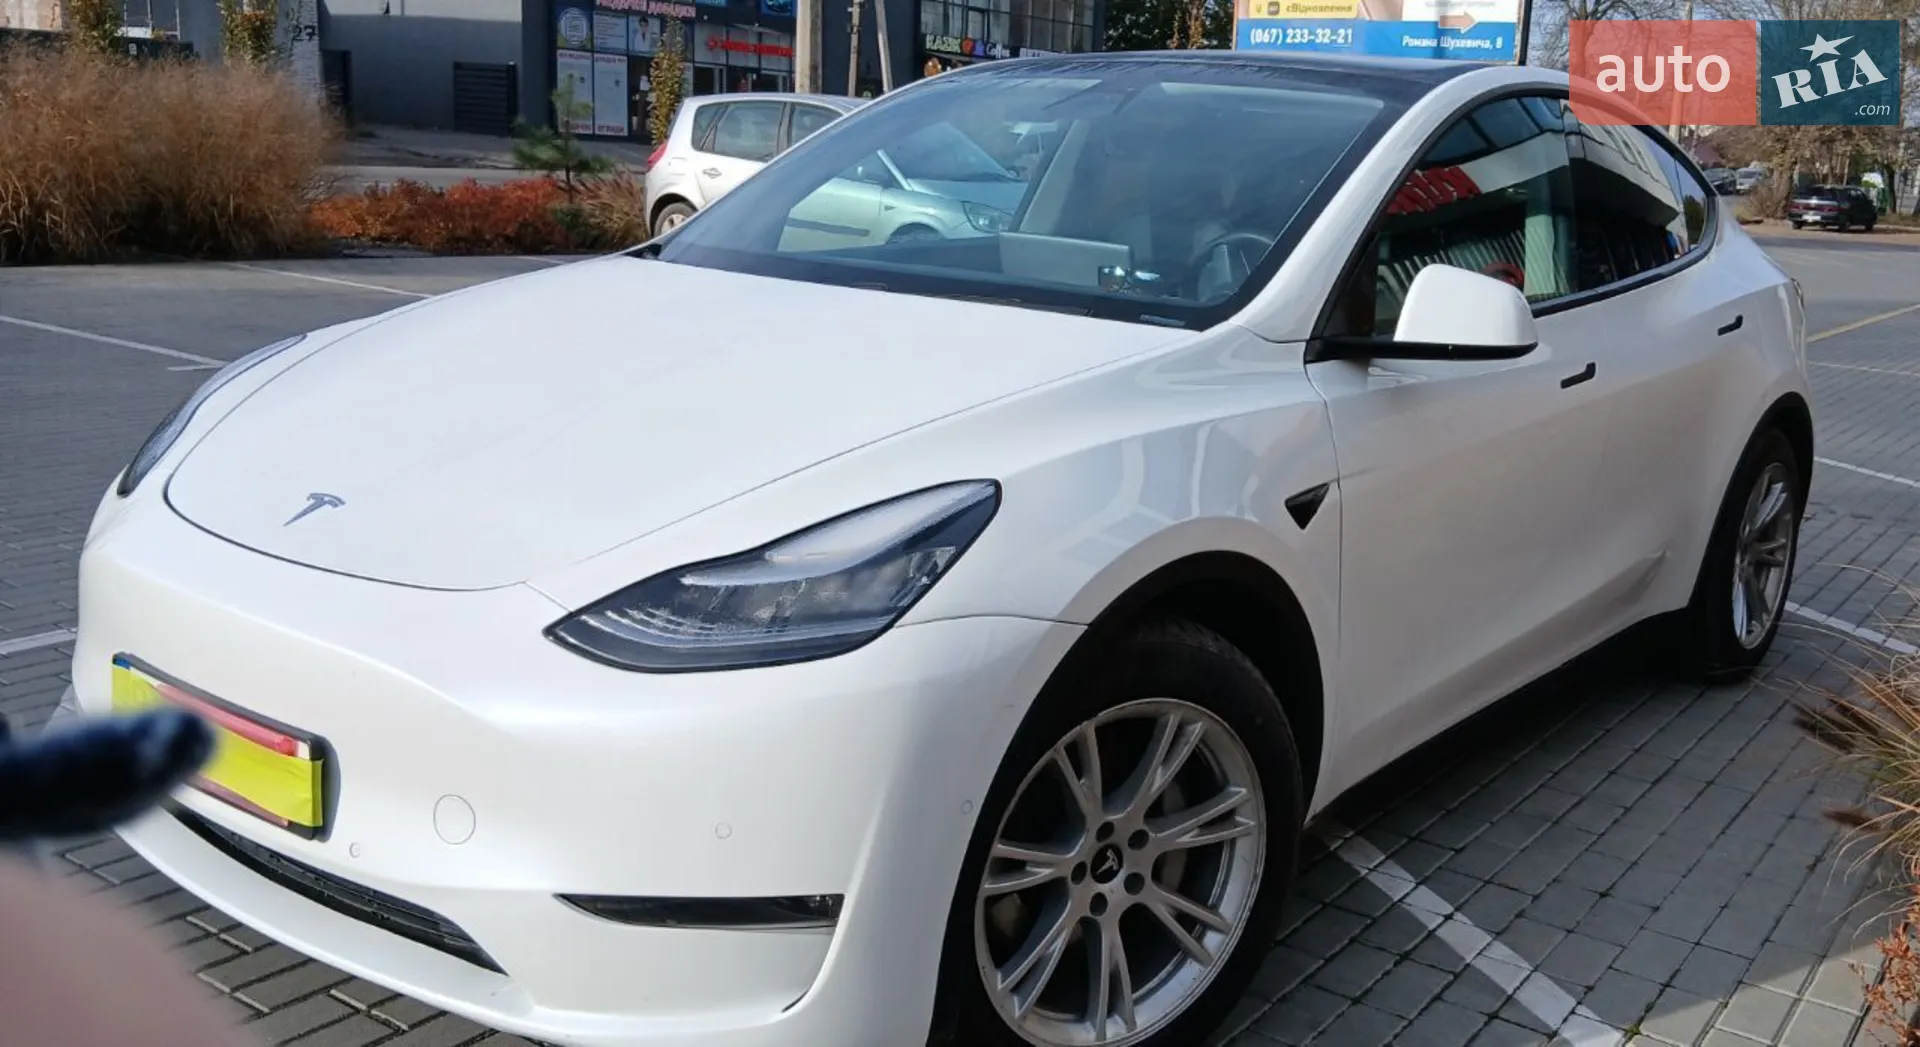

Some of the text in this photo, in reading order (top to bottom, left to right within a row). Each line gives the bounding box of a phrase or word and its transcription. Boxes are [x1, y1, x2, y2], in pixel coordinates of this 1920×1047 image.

[293, 25, 316, 41] 27
[1250, 27, 1353, 45] (067) 233-32-21
[1402, 36, 1438, 48] Романа
